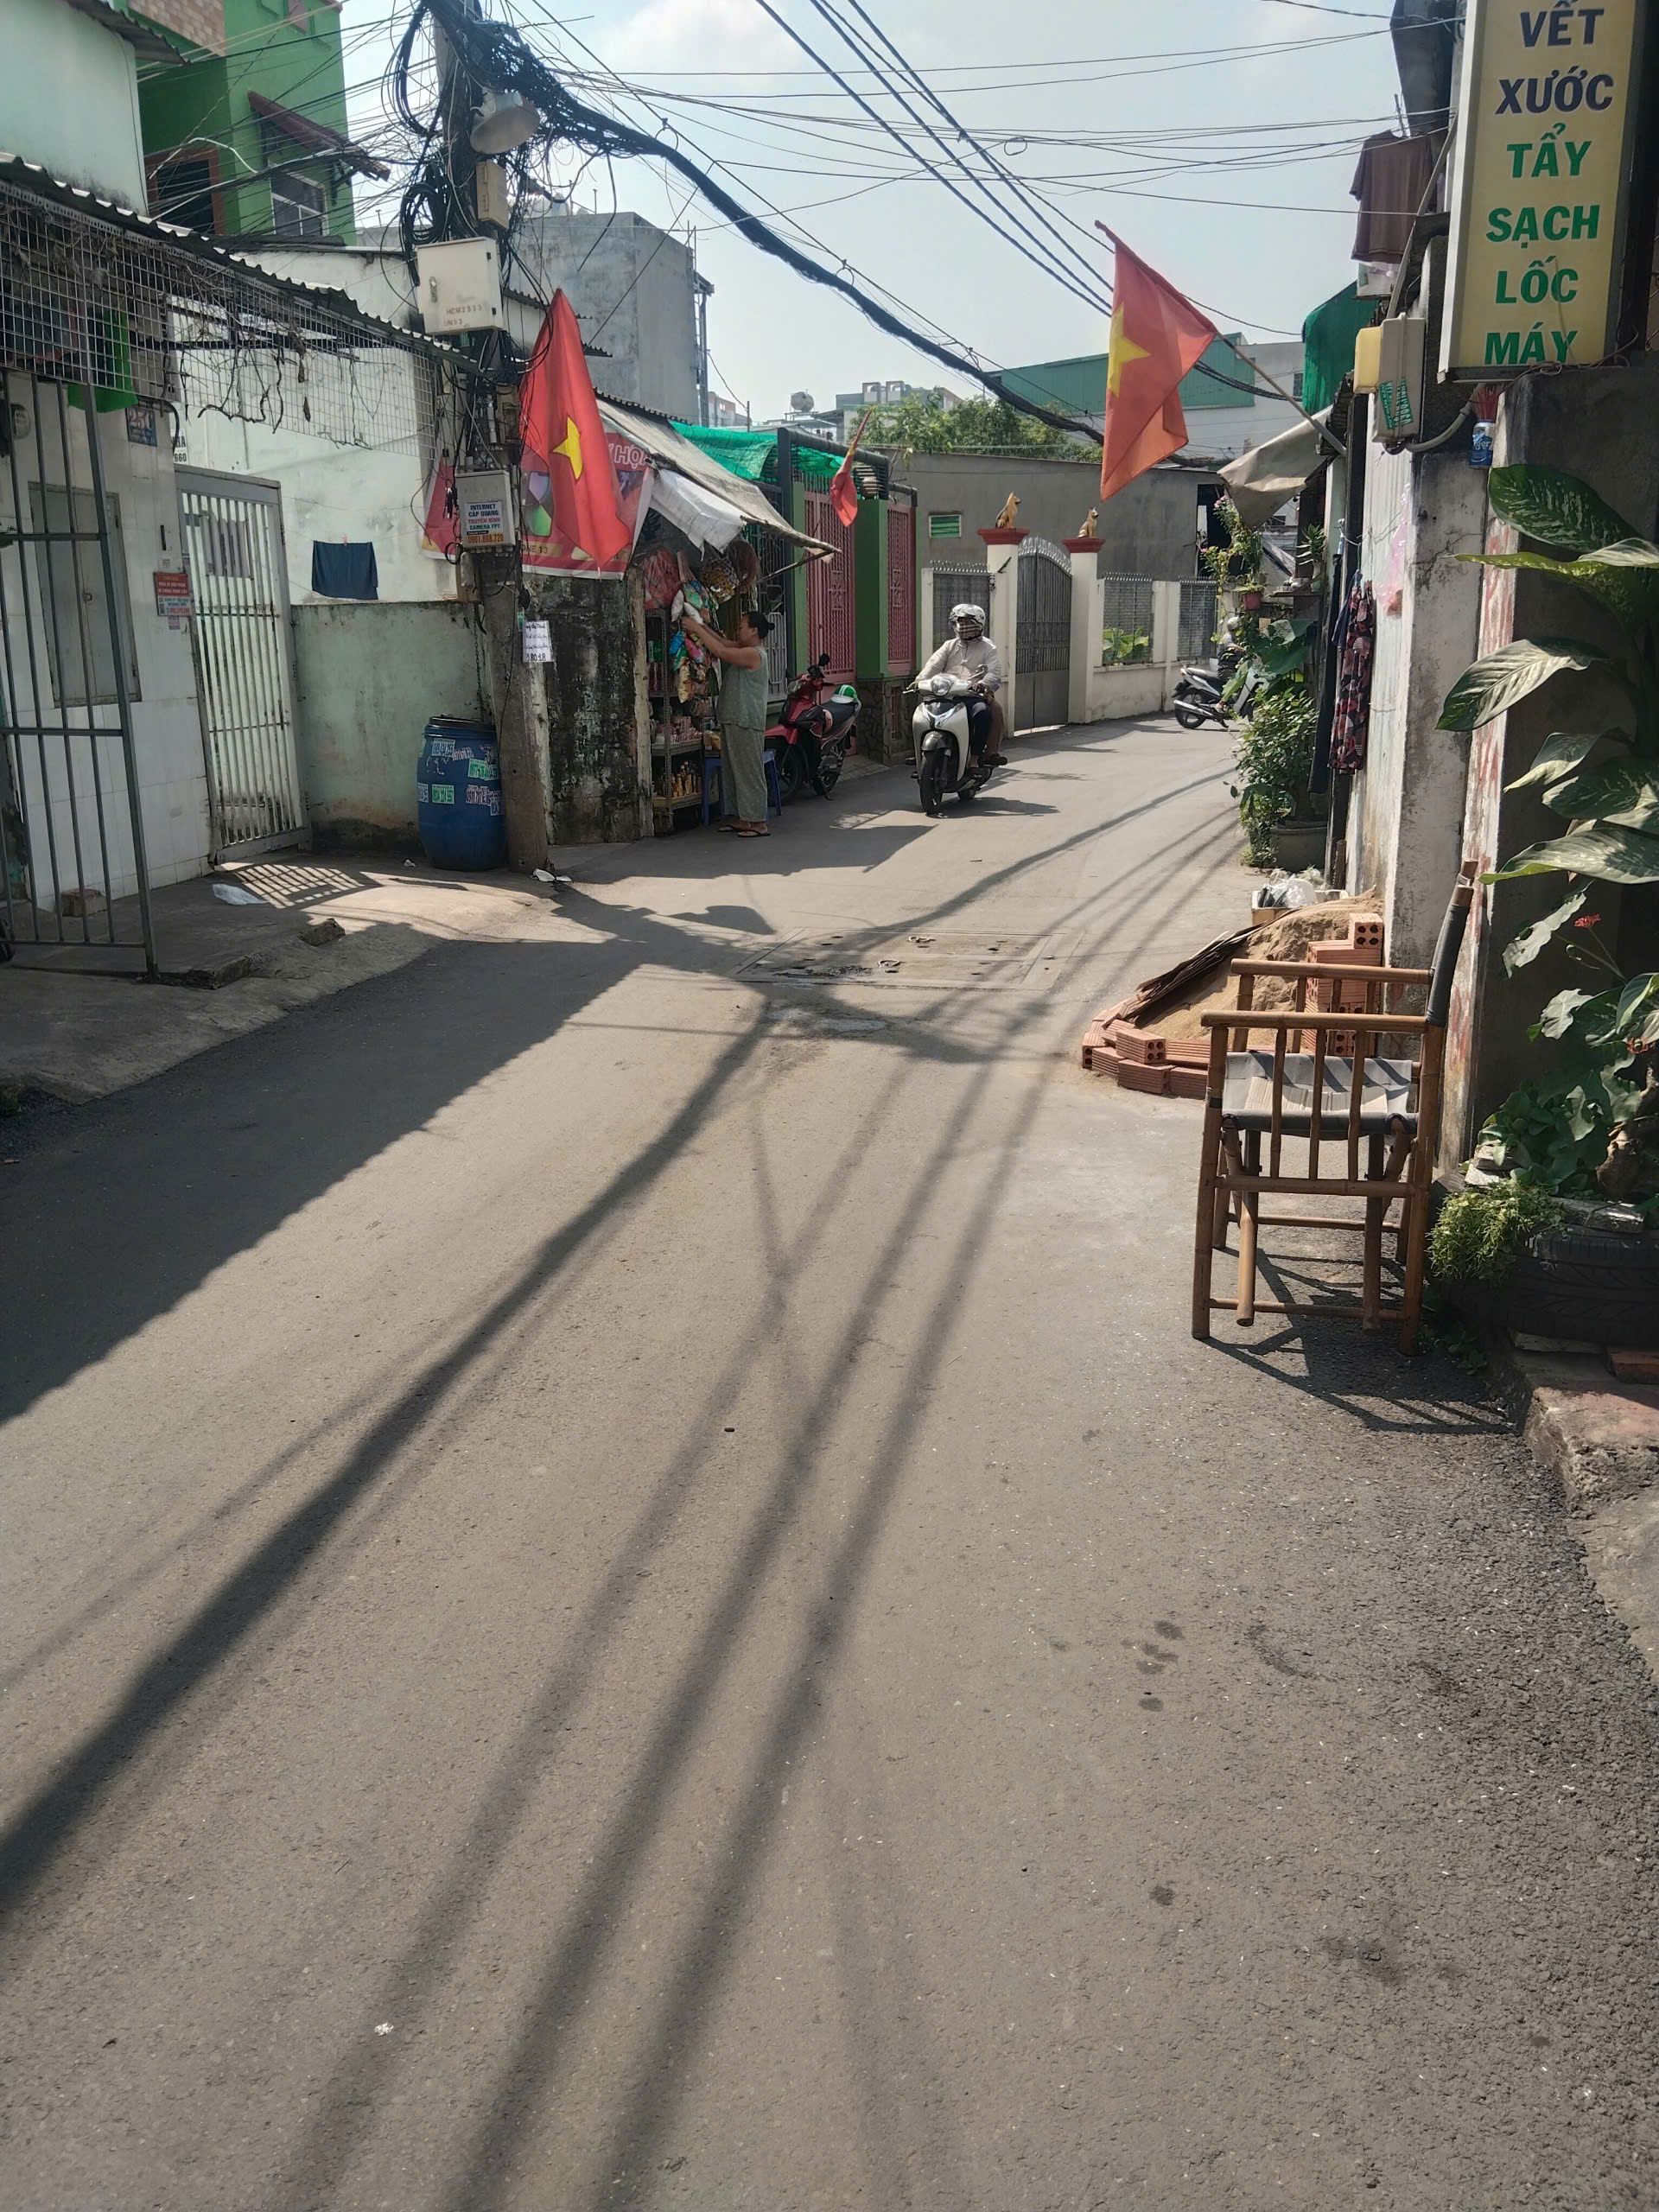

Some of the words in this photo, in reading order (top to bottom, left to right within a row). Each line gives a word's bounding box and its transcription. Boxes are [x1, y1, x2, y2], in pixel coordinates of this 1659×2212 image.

[1520, 0, 1605, 48] VẾT
[1495, 66, 1614, 115] XƯỚC
[1506, 123, 1592, 179] TẨY
[1486, 205, 1600, 249] SẠCH
[1495, 256, 1579, 304] LỐC
[1484, 322, 1578, 365] MÁY
